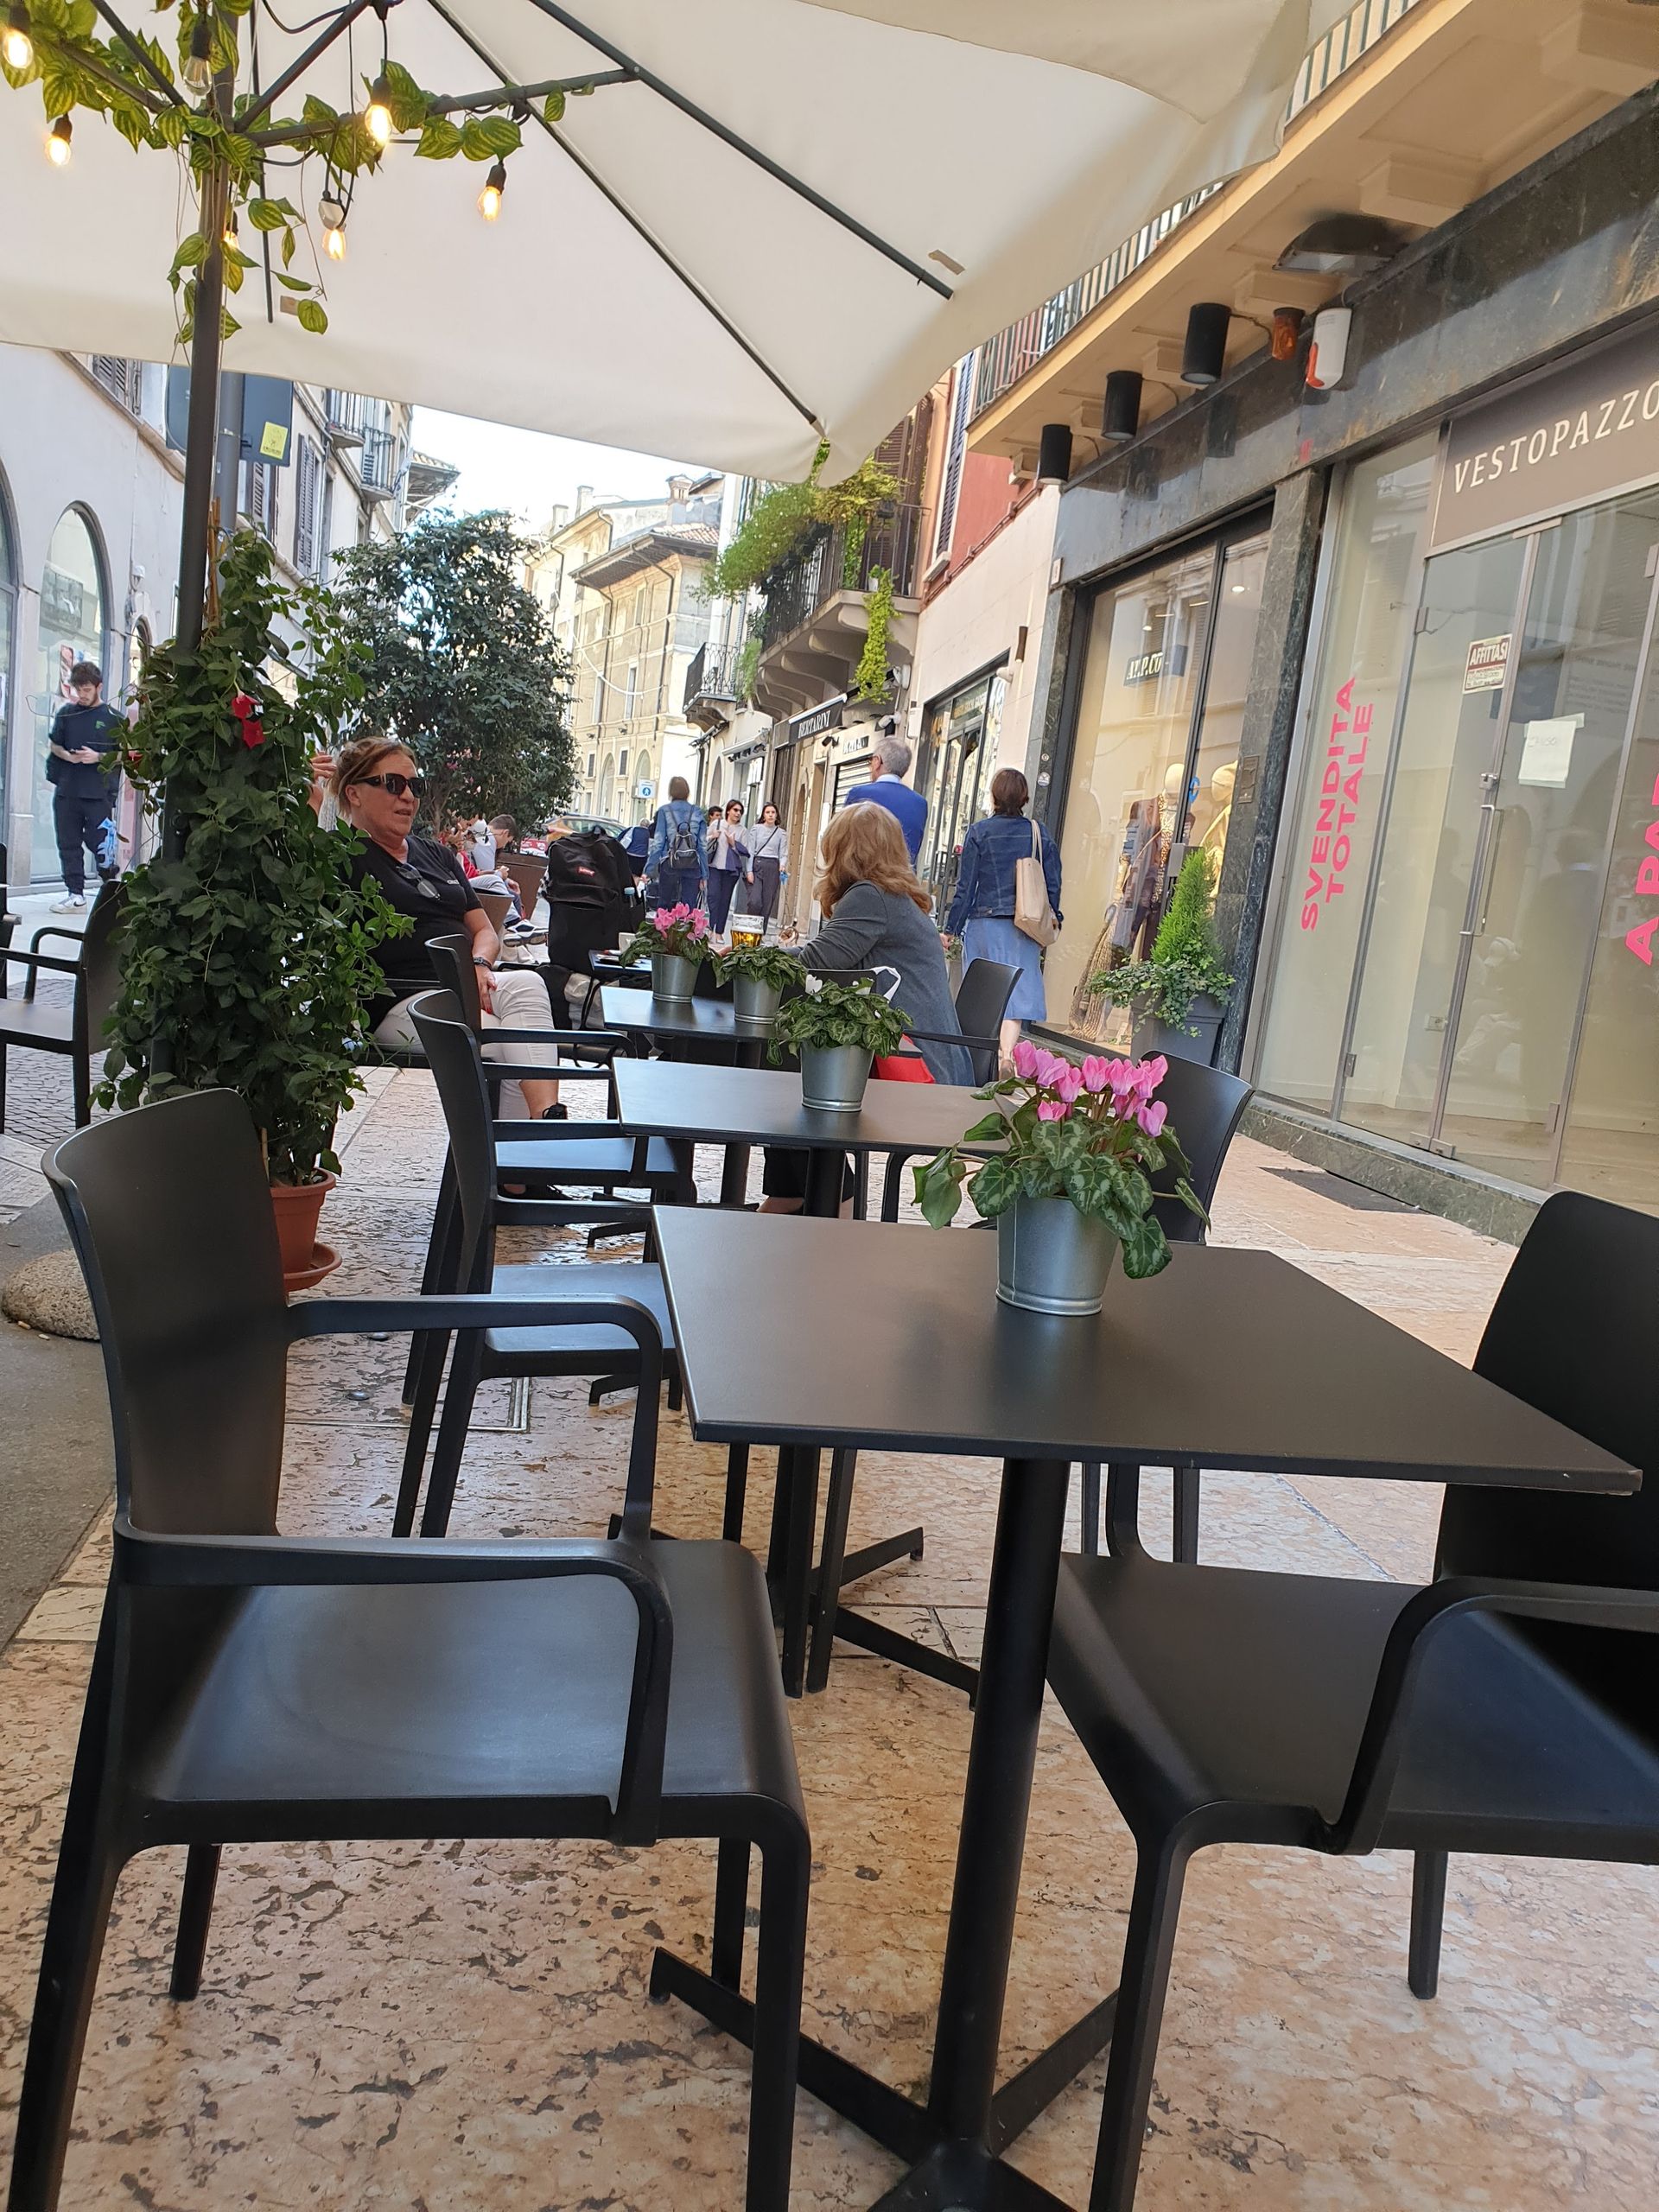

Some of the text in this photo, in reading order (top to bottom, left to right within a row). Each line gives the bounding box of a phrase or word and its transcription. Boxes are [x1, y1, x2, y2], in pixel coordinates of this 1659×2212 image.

[1454, 380, 1659, 493] VESTOPAZZO
[1470, 641, 1509, 666] AFFITTASI
[1300, 677, 1355, 931] SVENDITA
[1325, 703, 1374, 904] TOTALE
[1624, 916, 1659, 966] A
